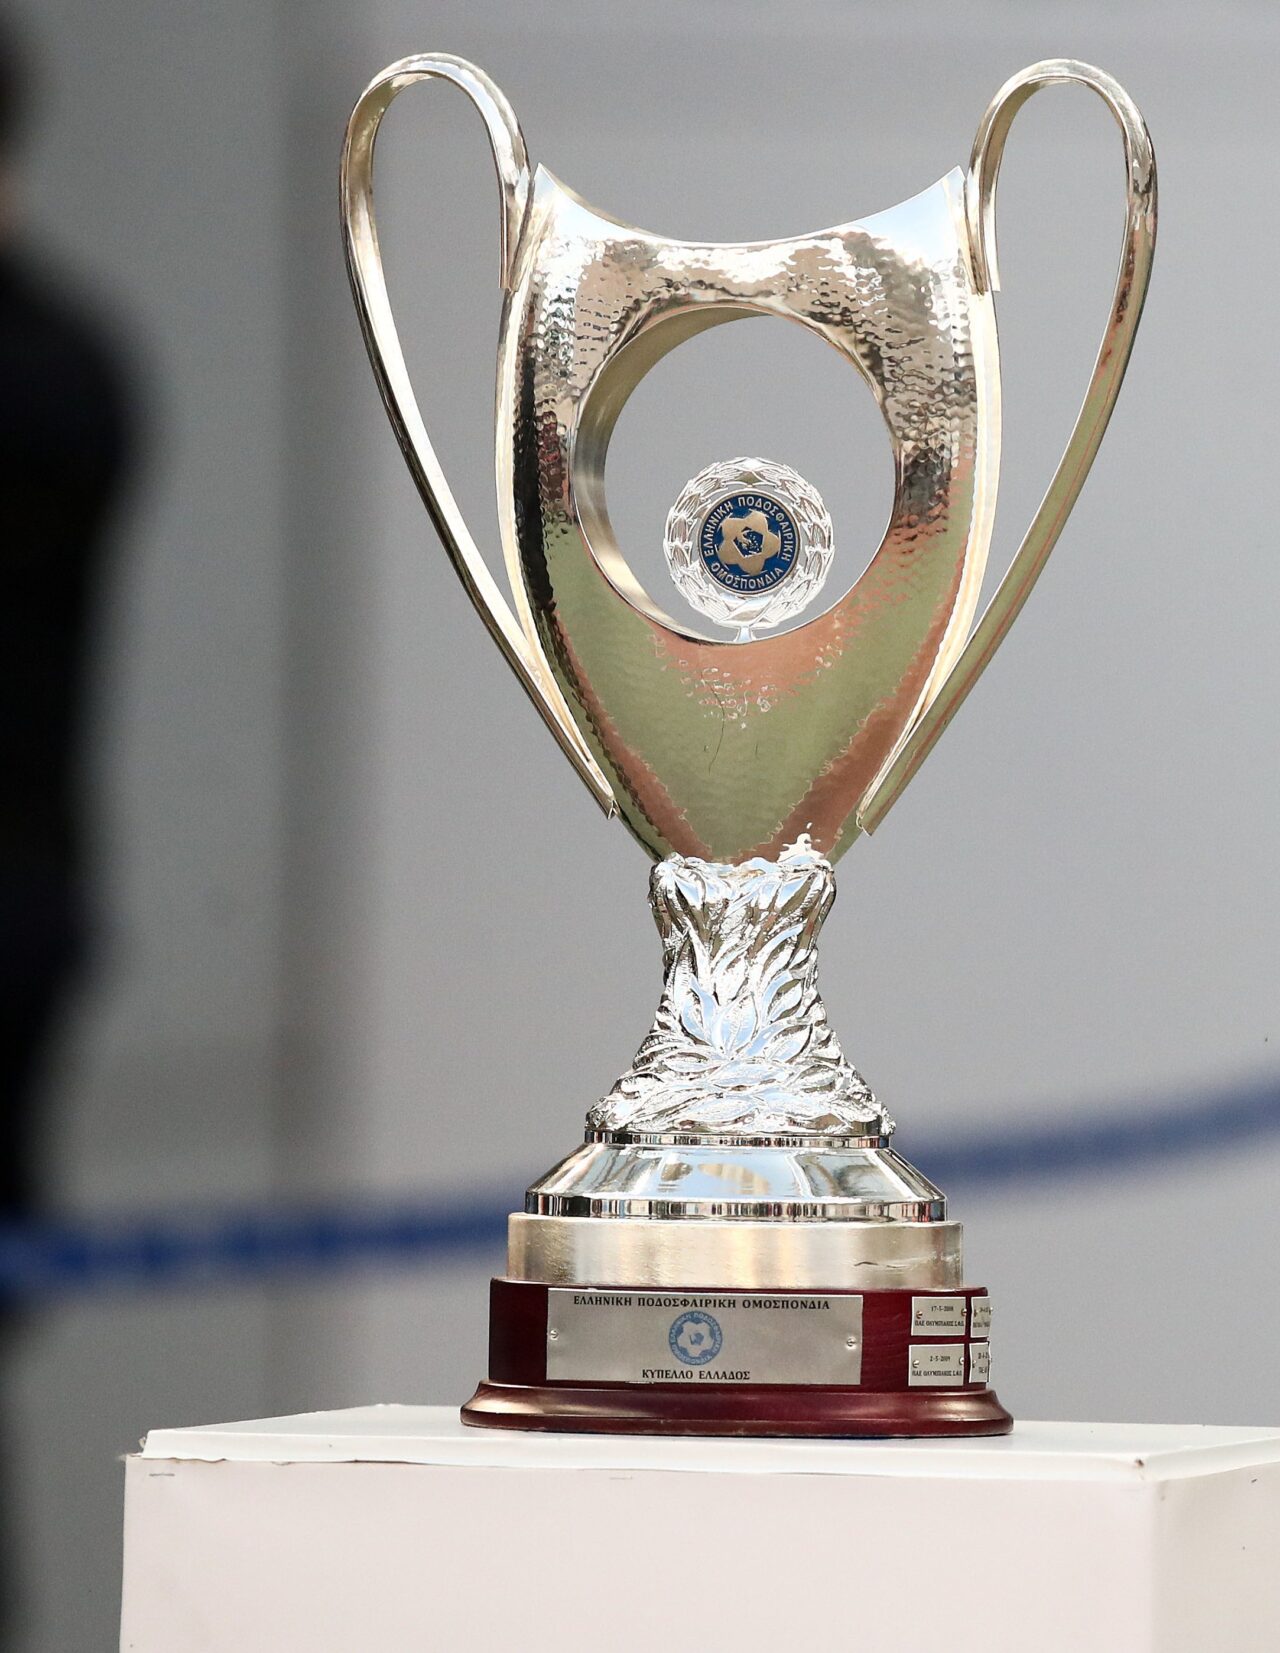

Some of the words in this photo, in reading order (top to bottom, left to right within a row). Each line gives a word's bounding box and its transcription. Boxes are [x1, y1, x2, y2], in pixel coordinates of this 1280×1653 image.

[703, 500, 734, 558] ΕΛΛΗΝΙΚΗ
[738, 496, 794, 562] ΠΟΔΟΣΦΑΙΡΙΚΗ
[711, 562, 784, 589] ΟΜΟΣΠΟΝΔΙΑ
[573, 1295, 632, 1306] ΕΛΛΗΝΙΚΗ
[637, 1297, 736, 1308] ΠΟΔΟΣΦΑΙΡΙΚΗ
[742, 1299, 830, 1310] ΟΜΟΣΠΟΝΔΙΑ
[642, 1369, 693, 1380] ΚΥΠΕΛΛΟ
[699, 1370, 751, 1380] ΕΛΛΑΔΟΣ
